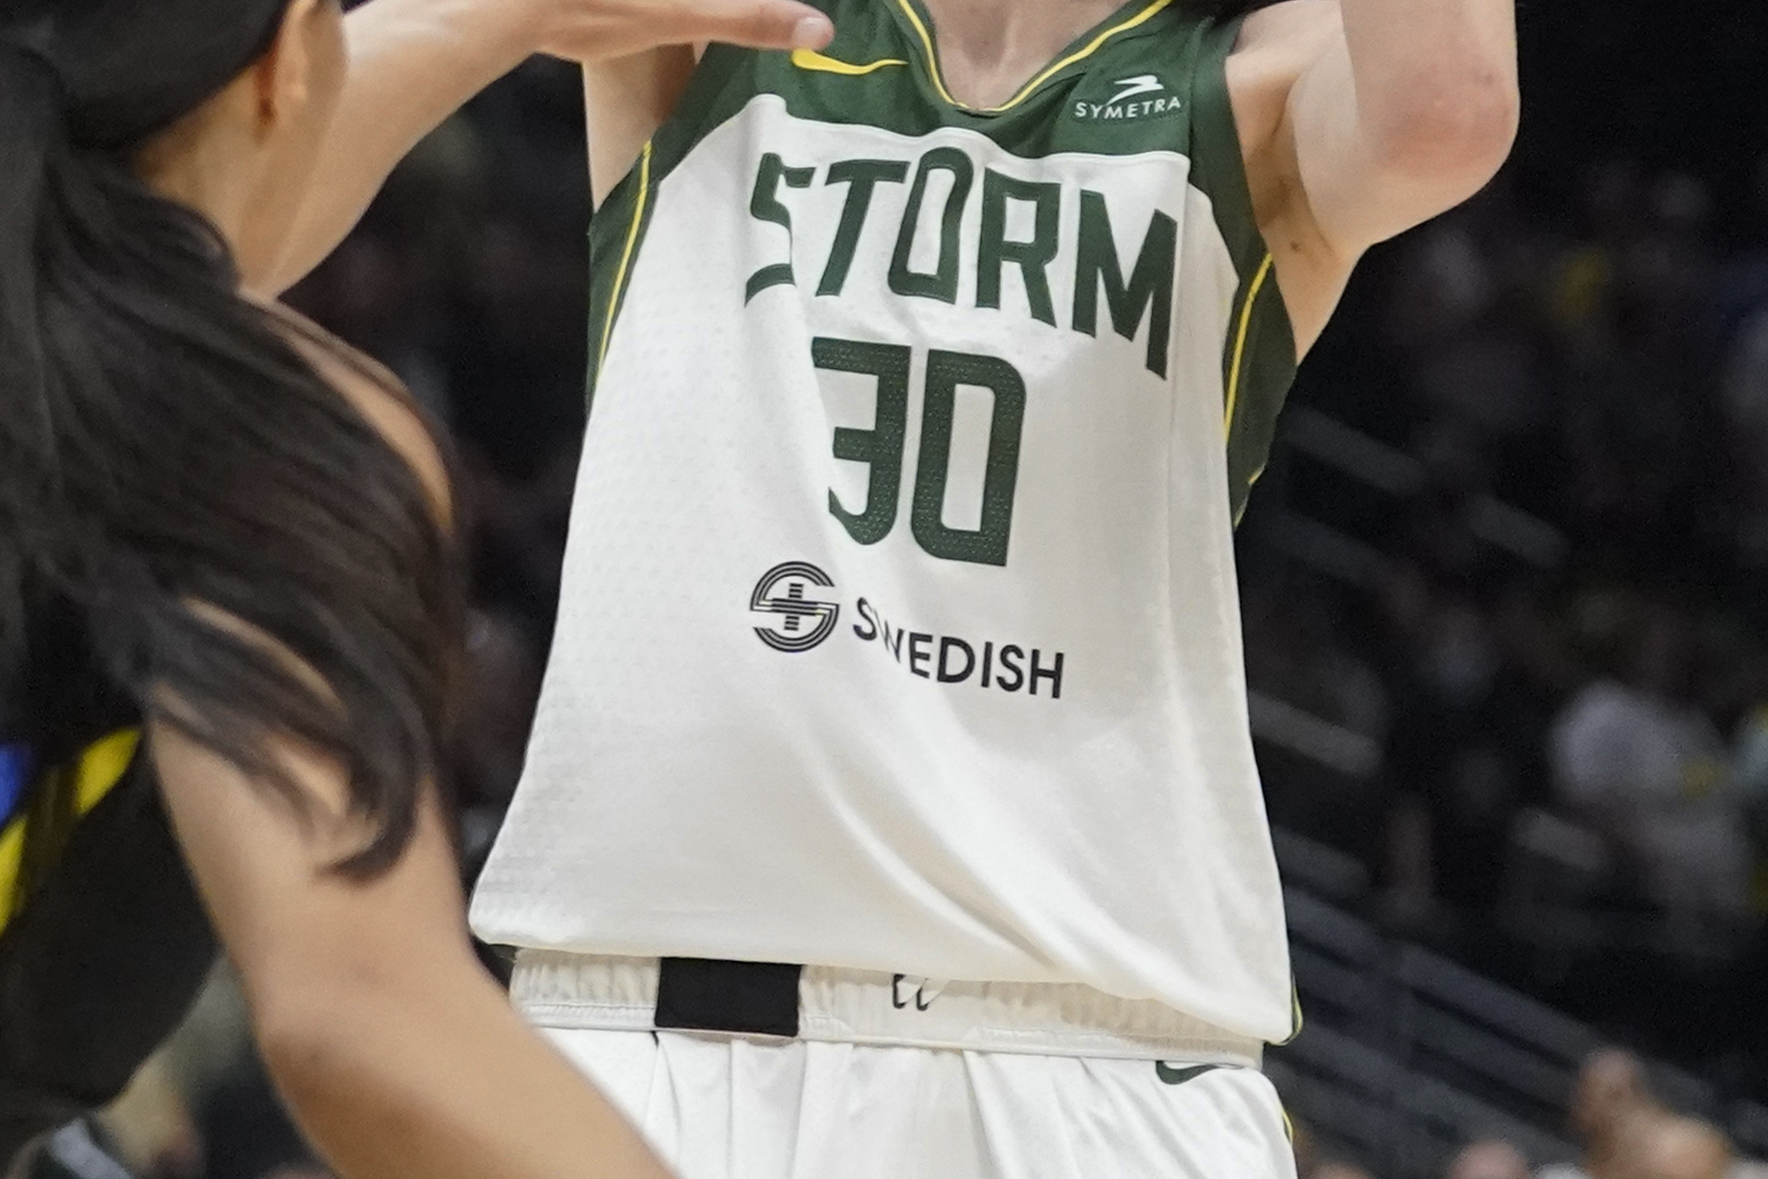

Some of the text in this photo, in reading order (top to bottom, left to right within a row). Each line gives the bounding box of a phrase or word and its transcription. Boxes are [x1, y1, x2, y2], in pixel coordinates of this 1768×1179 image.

[1074, 96, 1181, 120] SYMETRA
[744, 146, 1178, 381] STORM
[811, 336, 1027, 567] 30
[853, 596, 1064, 699] SWEDISH
